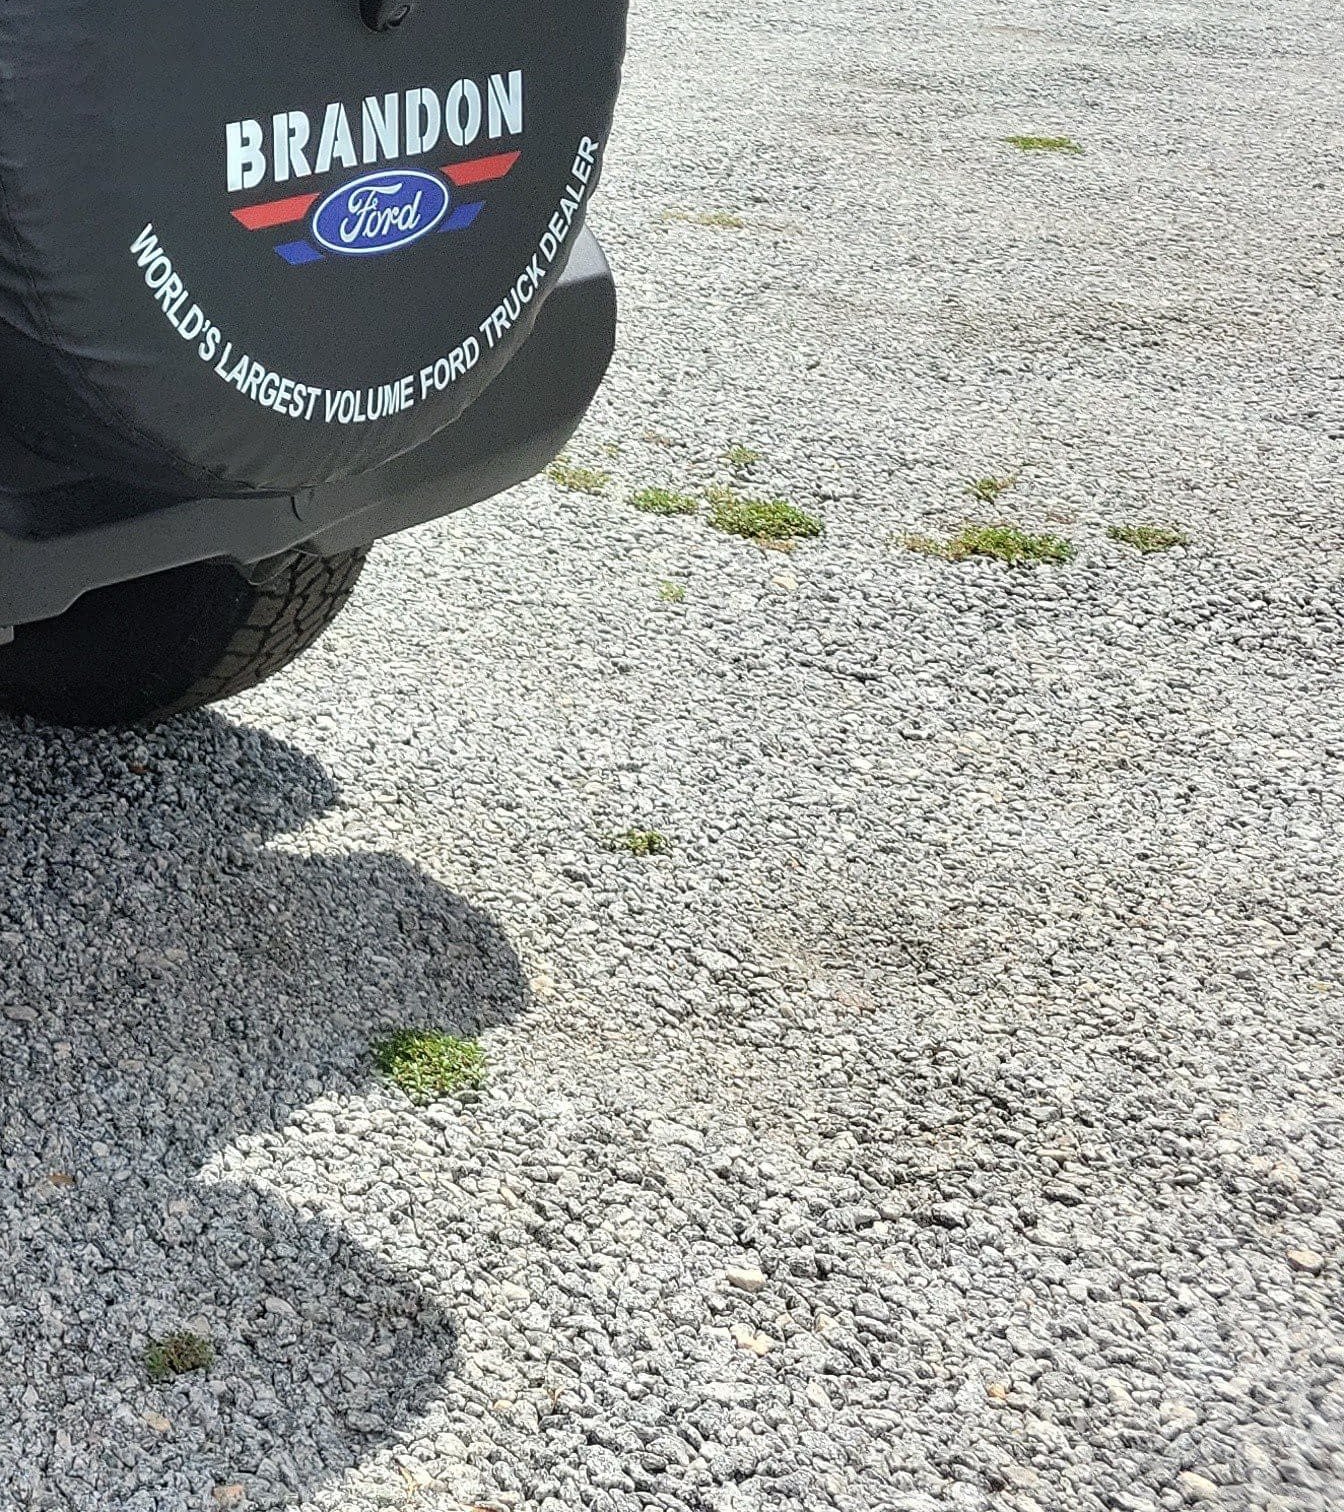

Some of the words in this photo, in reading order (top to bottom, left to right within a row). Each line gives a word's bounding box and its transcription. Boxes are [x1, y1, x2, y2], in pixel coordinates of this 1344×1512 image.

[225, 69, 523, 193] BRANDON
[339, 182, 423, 244] Ford
[129, 223, 222, 362] WORLD'S
[214, 342, 322, 421] LARGEST
[324, 374, 415, 425] VOLUME
[419, 336, 480, 400] FORD
[479, 253, 546, 348] TRUCK
[539, 136, 599, 263] DEALER
